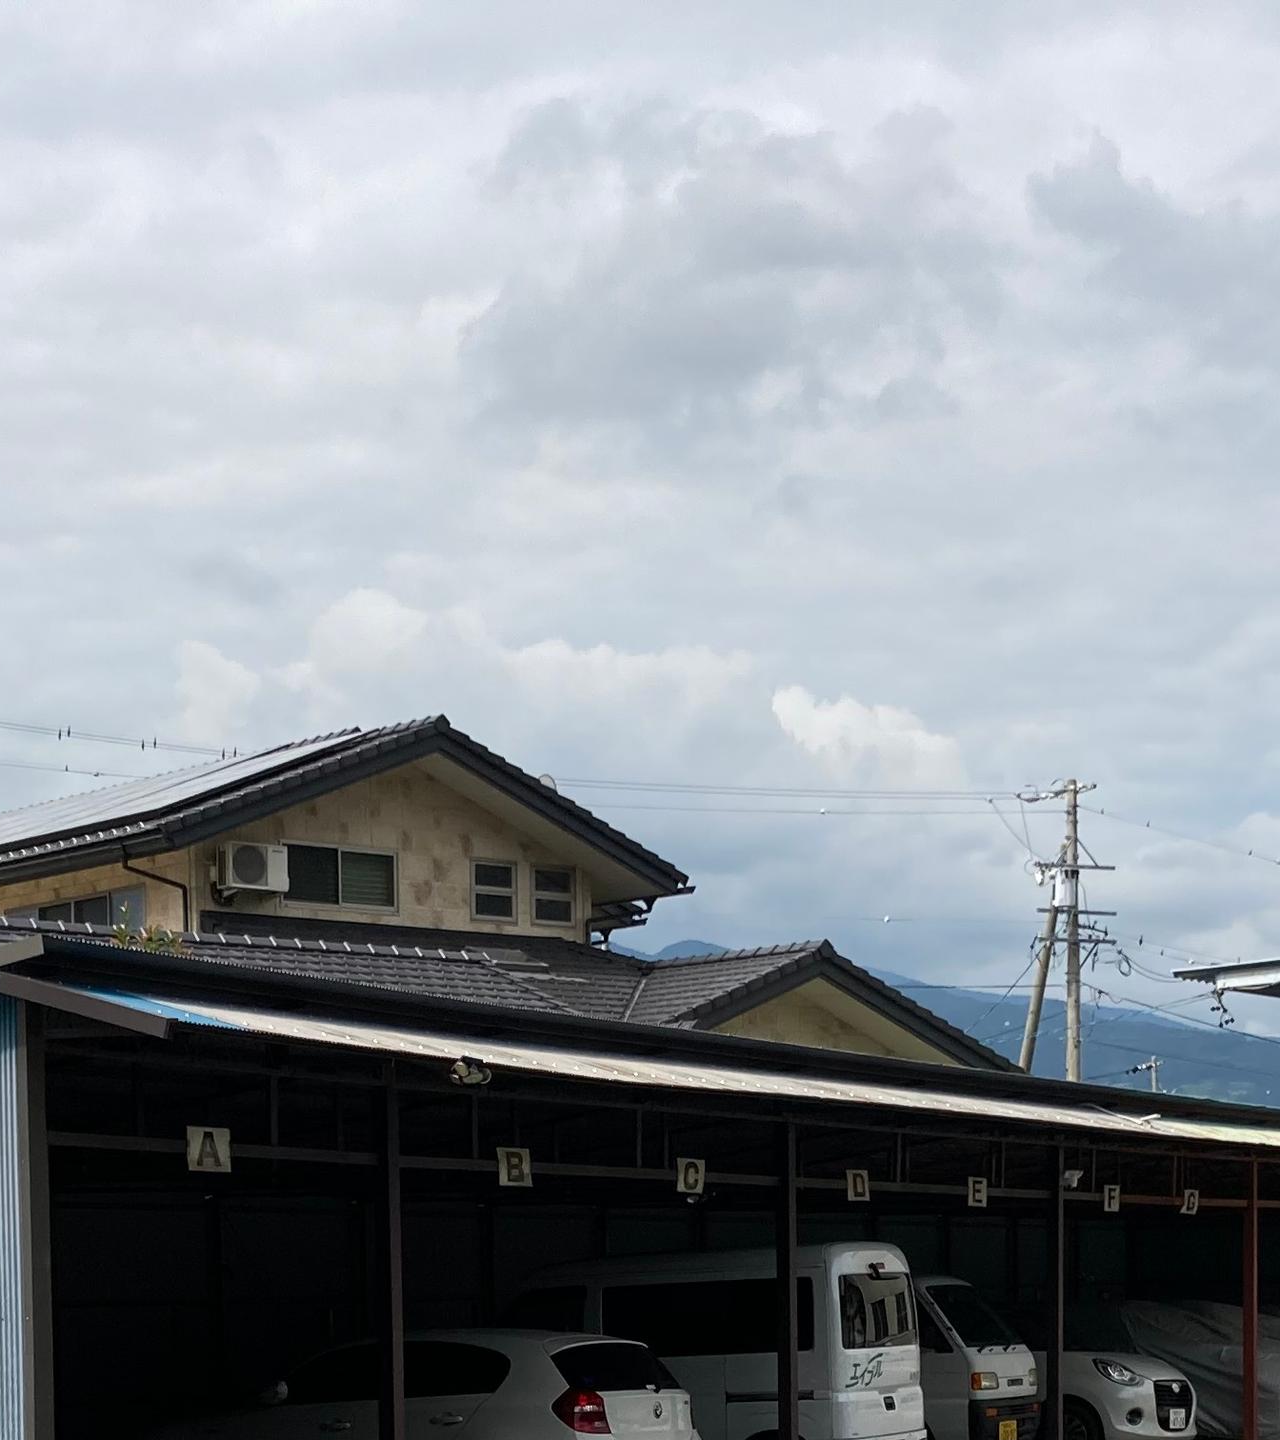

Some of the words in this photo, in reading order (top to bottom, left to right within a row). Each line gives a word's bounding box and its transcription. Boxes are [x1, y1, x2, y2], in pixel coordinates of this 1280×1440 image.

[196, 1131, 222, 1167] A
[505, 1151, 525, 1183] B
[683, 1161, 699, 1191] C
[852, 1173, 866, 1198] D
[972, 1180, 984, 1204] E
[1108, 1187, 1118, 1209] F
[1186, 1192, 1196, 1211] G
